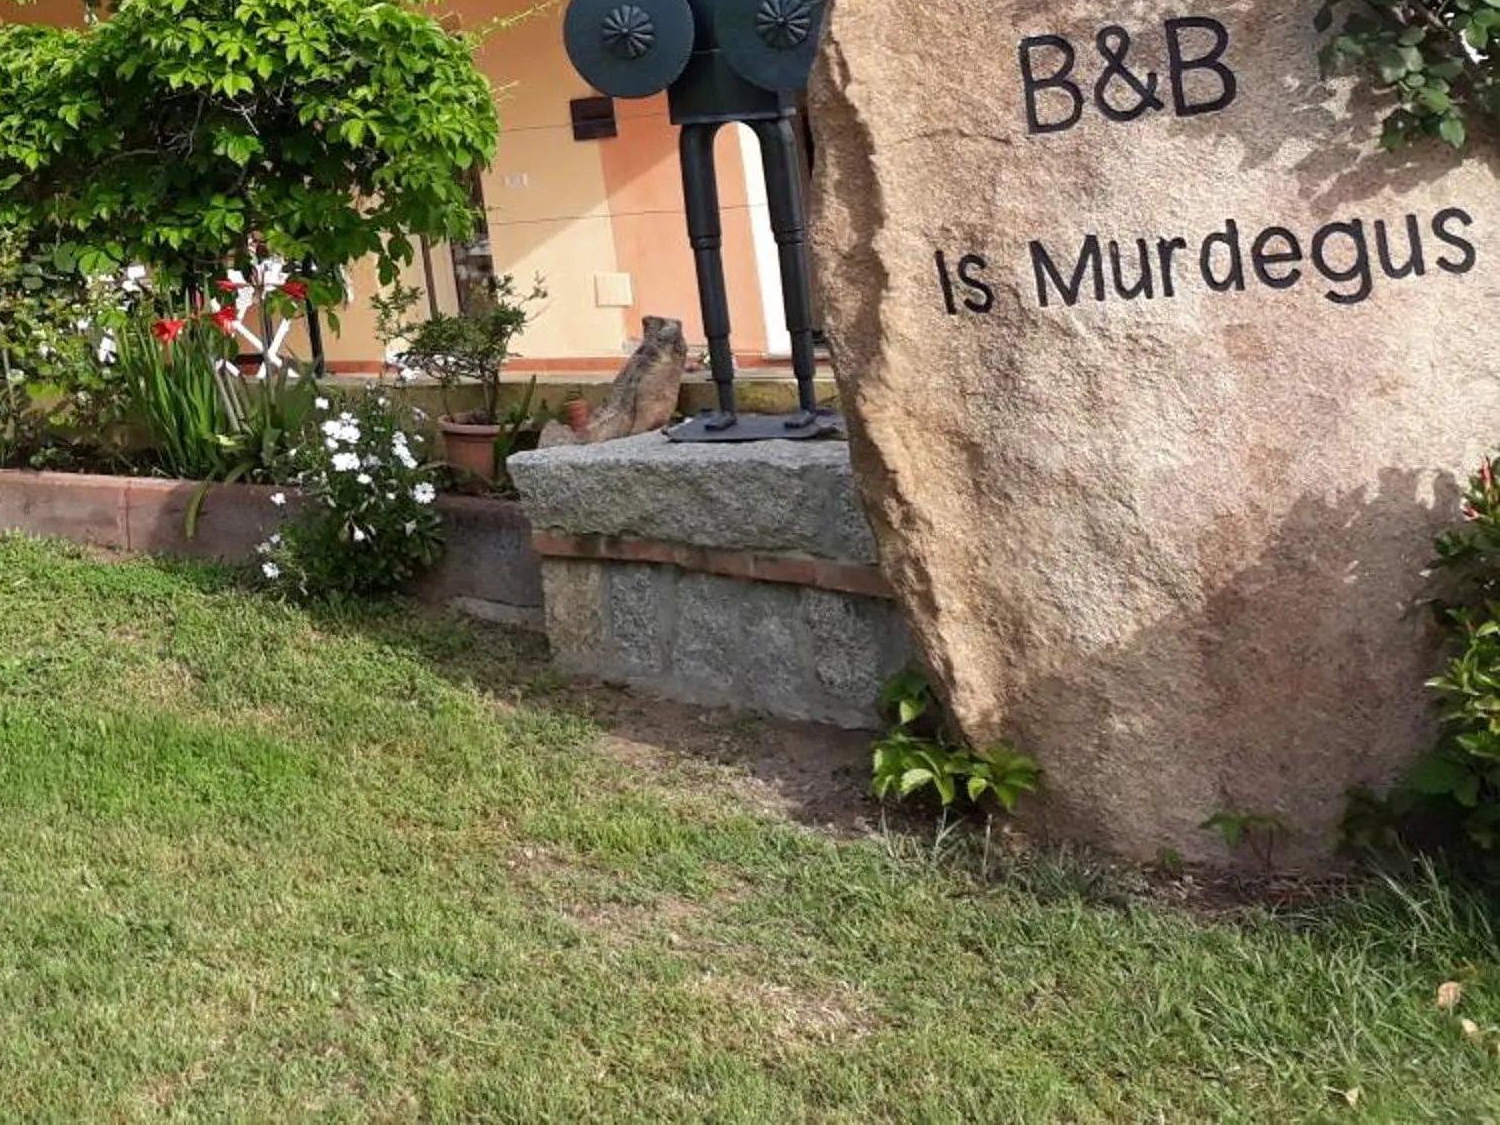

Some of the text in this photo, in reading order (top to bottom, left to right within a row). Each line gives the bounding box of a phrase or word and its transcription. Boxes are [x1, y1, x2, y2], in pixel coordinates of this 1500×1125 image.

[1017, 15, 1238, 135] B&B
[934, 206, 1478, 316] Is Murdegus
